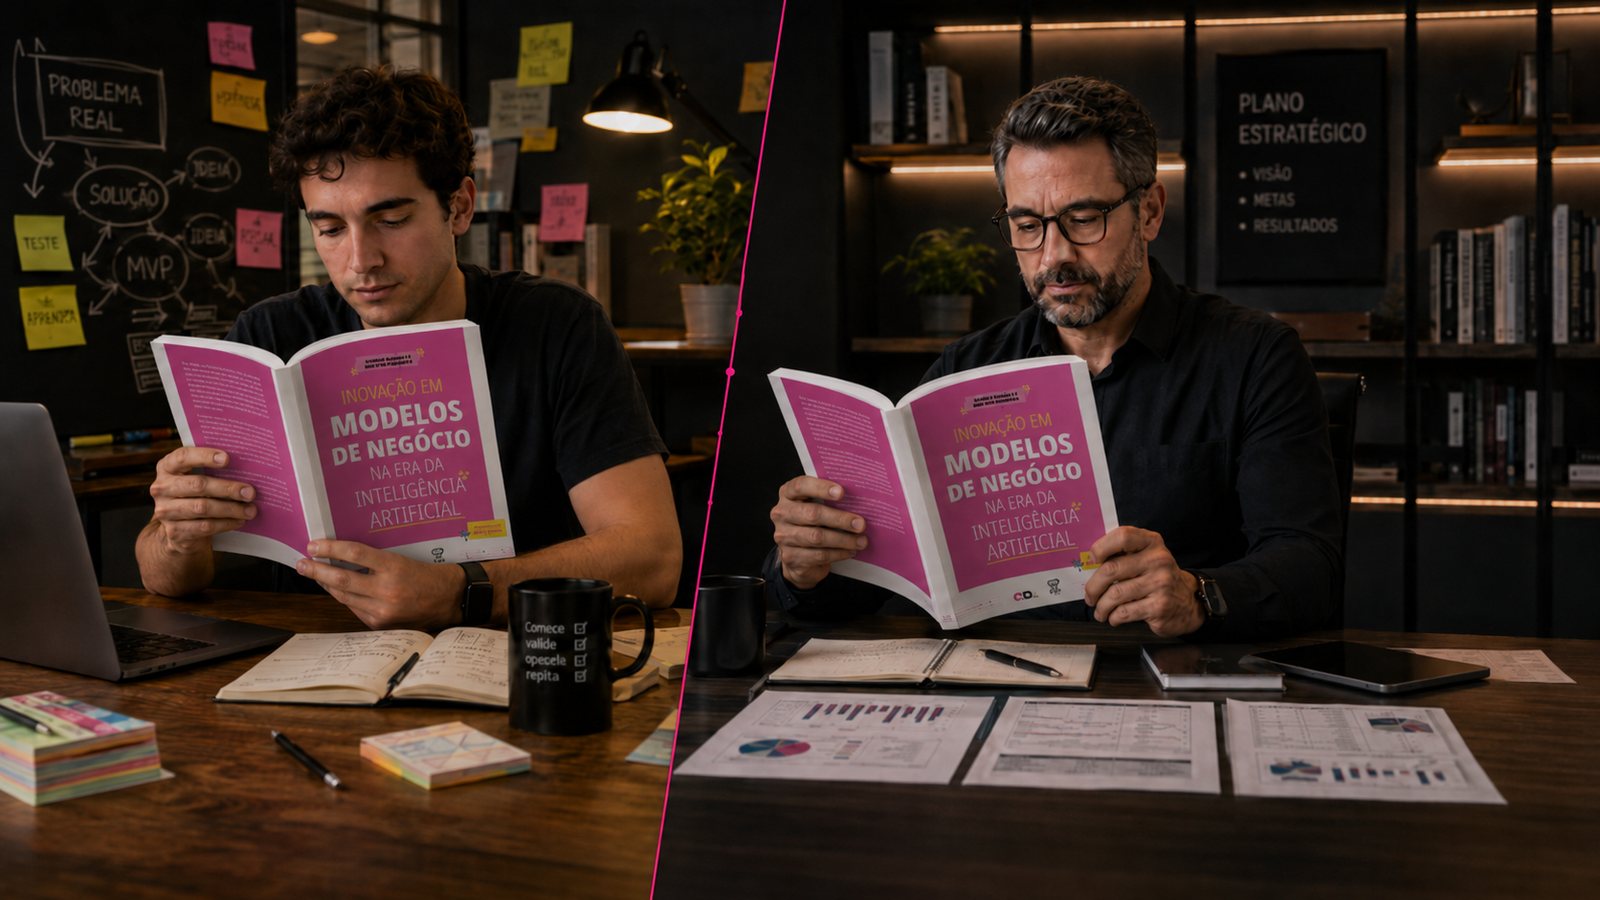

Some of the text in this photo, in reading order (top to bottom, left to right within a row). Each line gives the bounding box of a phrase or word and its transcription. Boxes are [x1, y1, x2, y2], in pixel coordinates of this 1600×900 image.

[48, 73, 143, 106] PROBLEMA
[1238, 91, 1305, 114] PLANO
[70, 106, 124, 133] REAL
[1238, 117, 1367, 145] ESTRATÉGICO
[192, 159, 232, 180] IDEIA
[1252, 163, 1293, 182] VISÃO
[89, 181, 160, 211] SOLUÇÃO
[1252, 192, 1297, 208] METAS
[190, 227, 229, 246] IDEIA
[1252, 217, 1339, 234] RESULTADOS
[23, 236, 60, 251] TESTE
[126, 254, 175, 282] MVP
[341, 378, 443, 405] INOVAÇÃO EM
[330, 400, 464, 439] MODELOS
[953, 412, 1053, 443] INOVAÇÃO EM
[331, 428, 471, 466] DE NEGÓCIO
[944, 432, 1074, 477] MODELOS
[370, 457, 445, 481] NA ERA DA
[946, 461, 1083, 503] DE NEGÓCIO
[355, 477, 467, 508] INTELIGÊNCIA
[985, 490, 1057, 515] NA ERA DA
[370, 499, 462, 529] ARTIFICIAL
[972, 508, 1080, 541] INTELIGÊNCIA
[987, 530, 1076, 561] ARTIFICIAL
[524, 621, 566, 635] Comece
[525, 637, 557, 650] valide
[525, 669, 560, 684] repita
